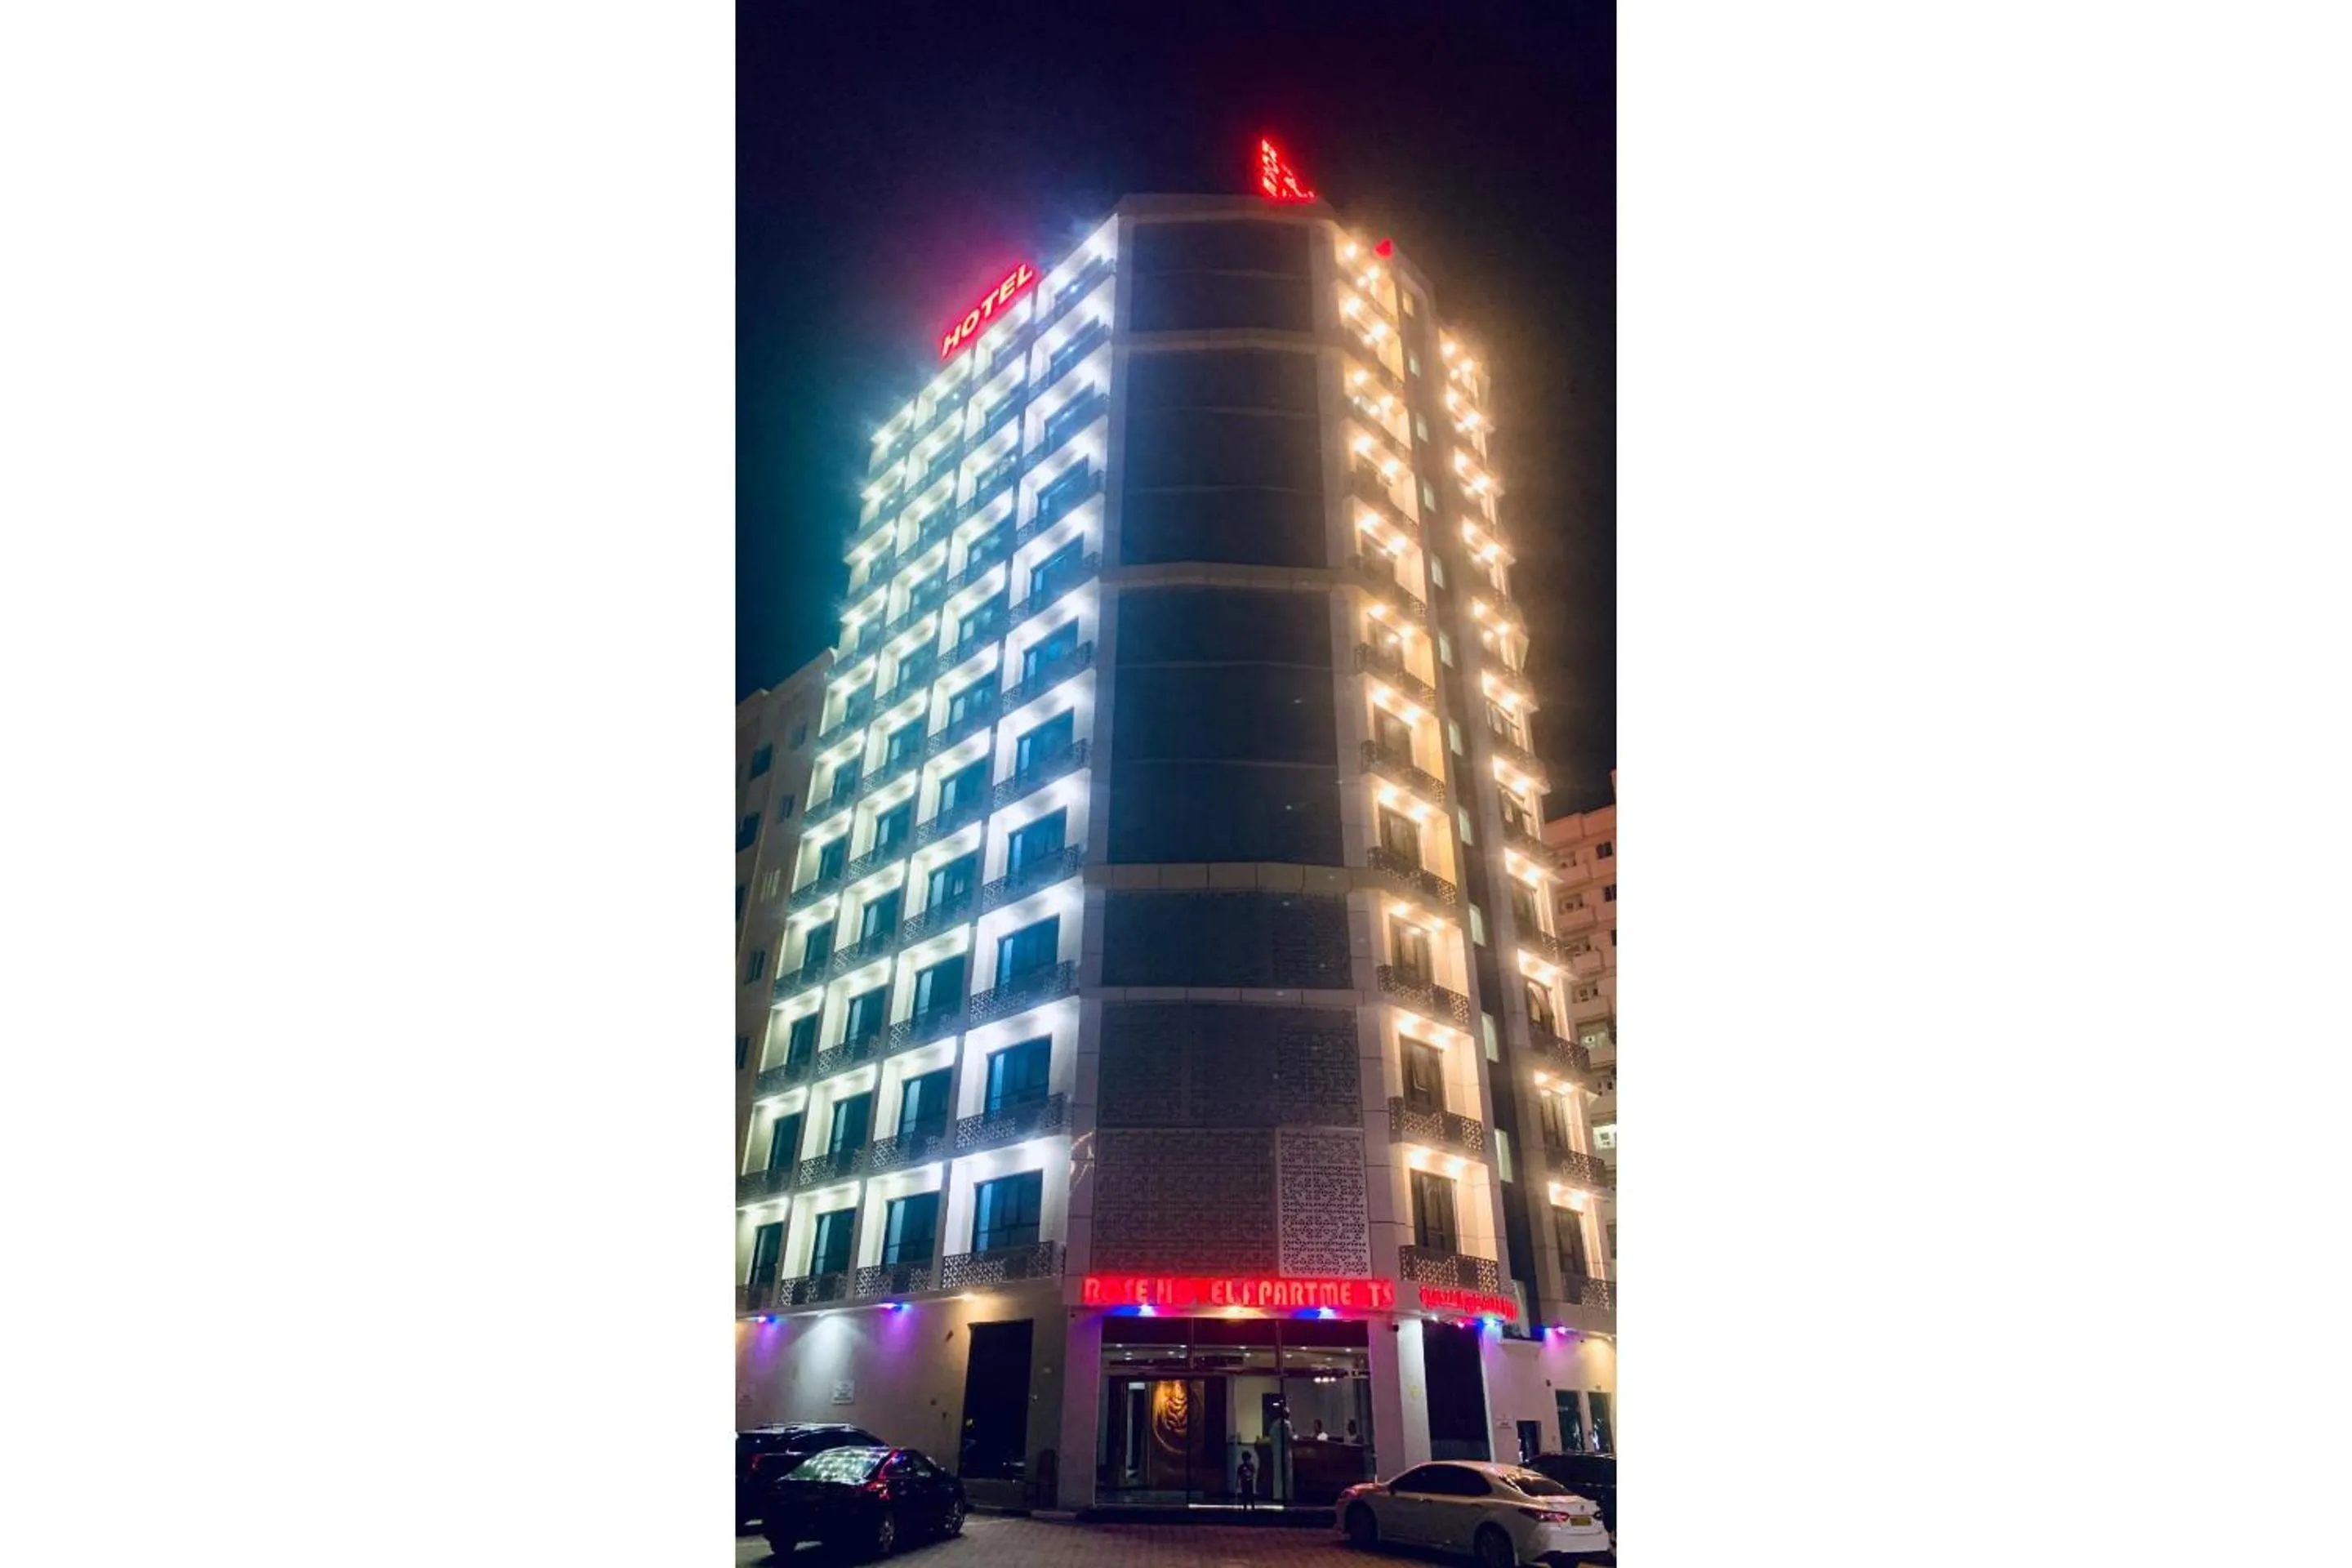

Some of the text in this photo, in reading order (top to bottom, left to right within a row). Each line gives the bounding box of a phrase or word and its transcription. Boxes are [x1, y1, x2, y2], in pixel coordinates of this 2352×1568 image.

[942, 263, 1033, 358] HOTEL
[1084, 1277, 1148, 1304] RSE
[1157, 1279, 1236, 1305] HEL
